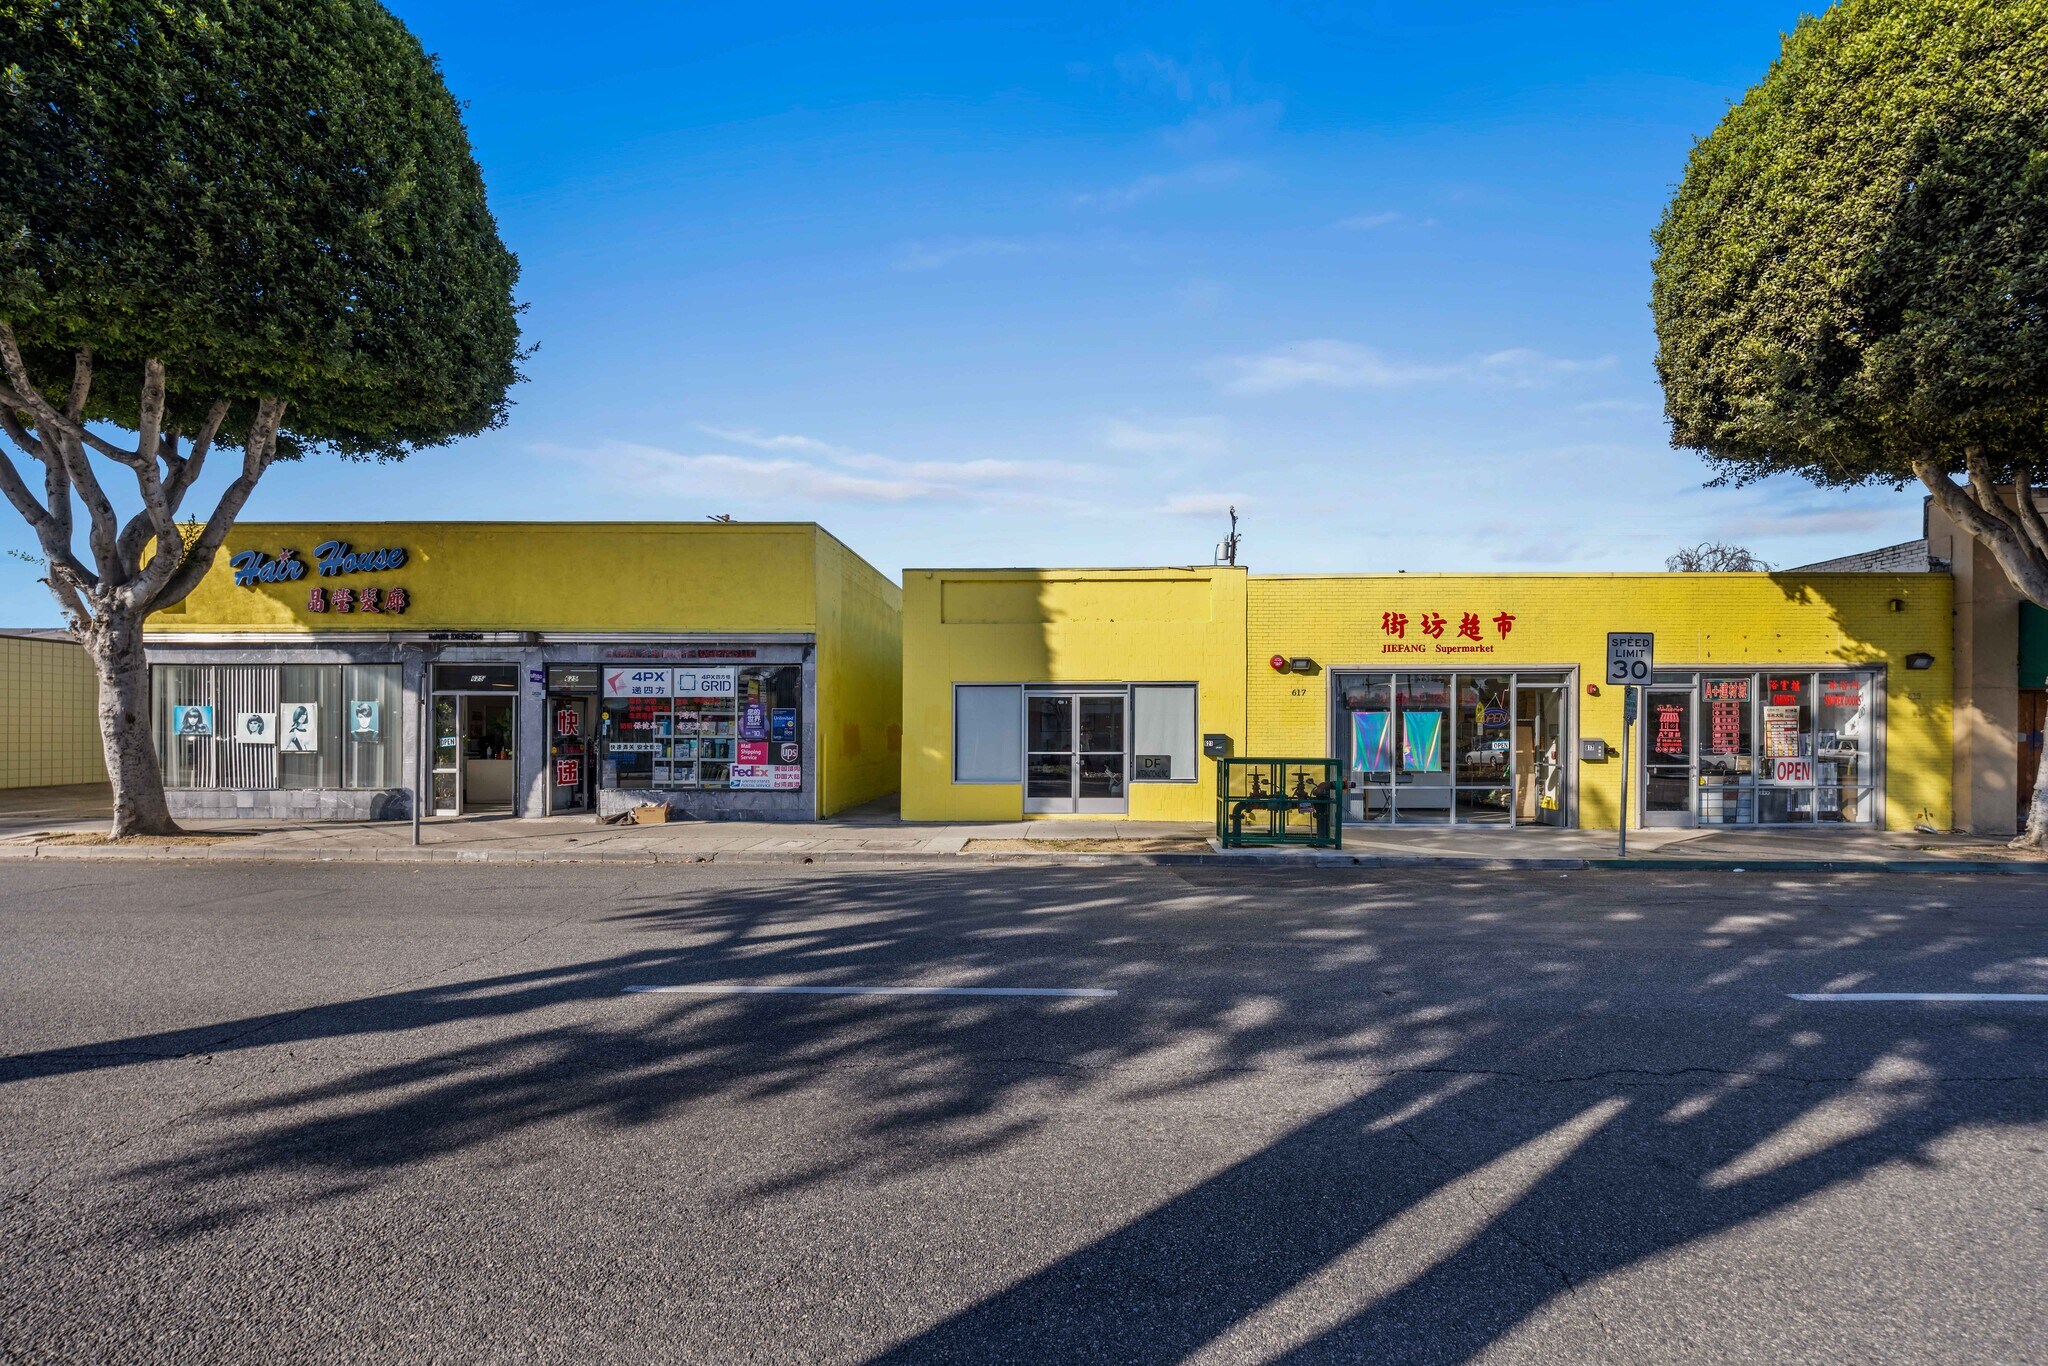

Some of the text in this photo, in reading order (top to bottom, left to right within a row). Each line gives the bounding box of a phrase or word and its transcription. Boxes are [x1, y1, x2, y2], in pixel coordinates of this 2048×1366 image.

[229, 540, 405, 586] Hair House
[1381, 611, 1517, 642] 街坊超市
[1611, 638, 1650, 647] SPEED
[1381, 644, 1494, 655] JIEFANG Supermarket
[1615, 649, 1646, 658] LIMIT
[1611, 660, 1648, 679] 30
[632, 671, 665, 682] 4PX
[632, 686, 665, 695] 递四方
[701, 680, 732, 692] GRID
[1291, 689, 1307, 697] 617
[441, 738, 455, 746] OPEN
[782, 749, 797, 760] ups
[1145, 758, 1161, 768] DF
[731, 765, 769, 777] FedEx
[1777, 761, 1811, 780] OPEN
